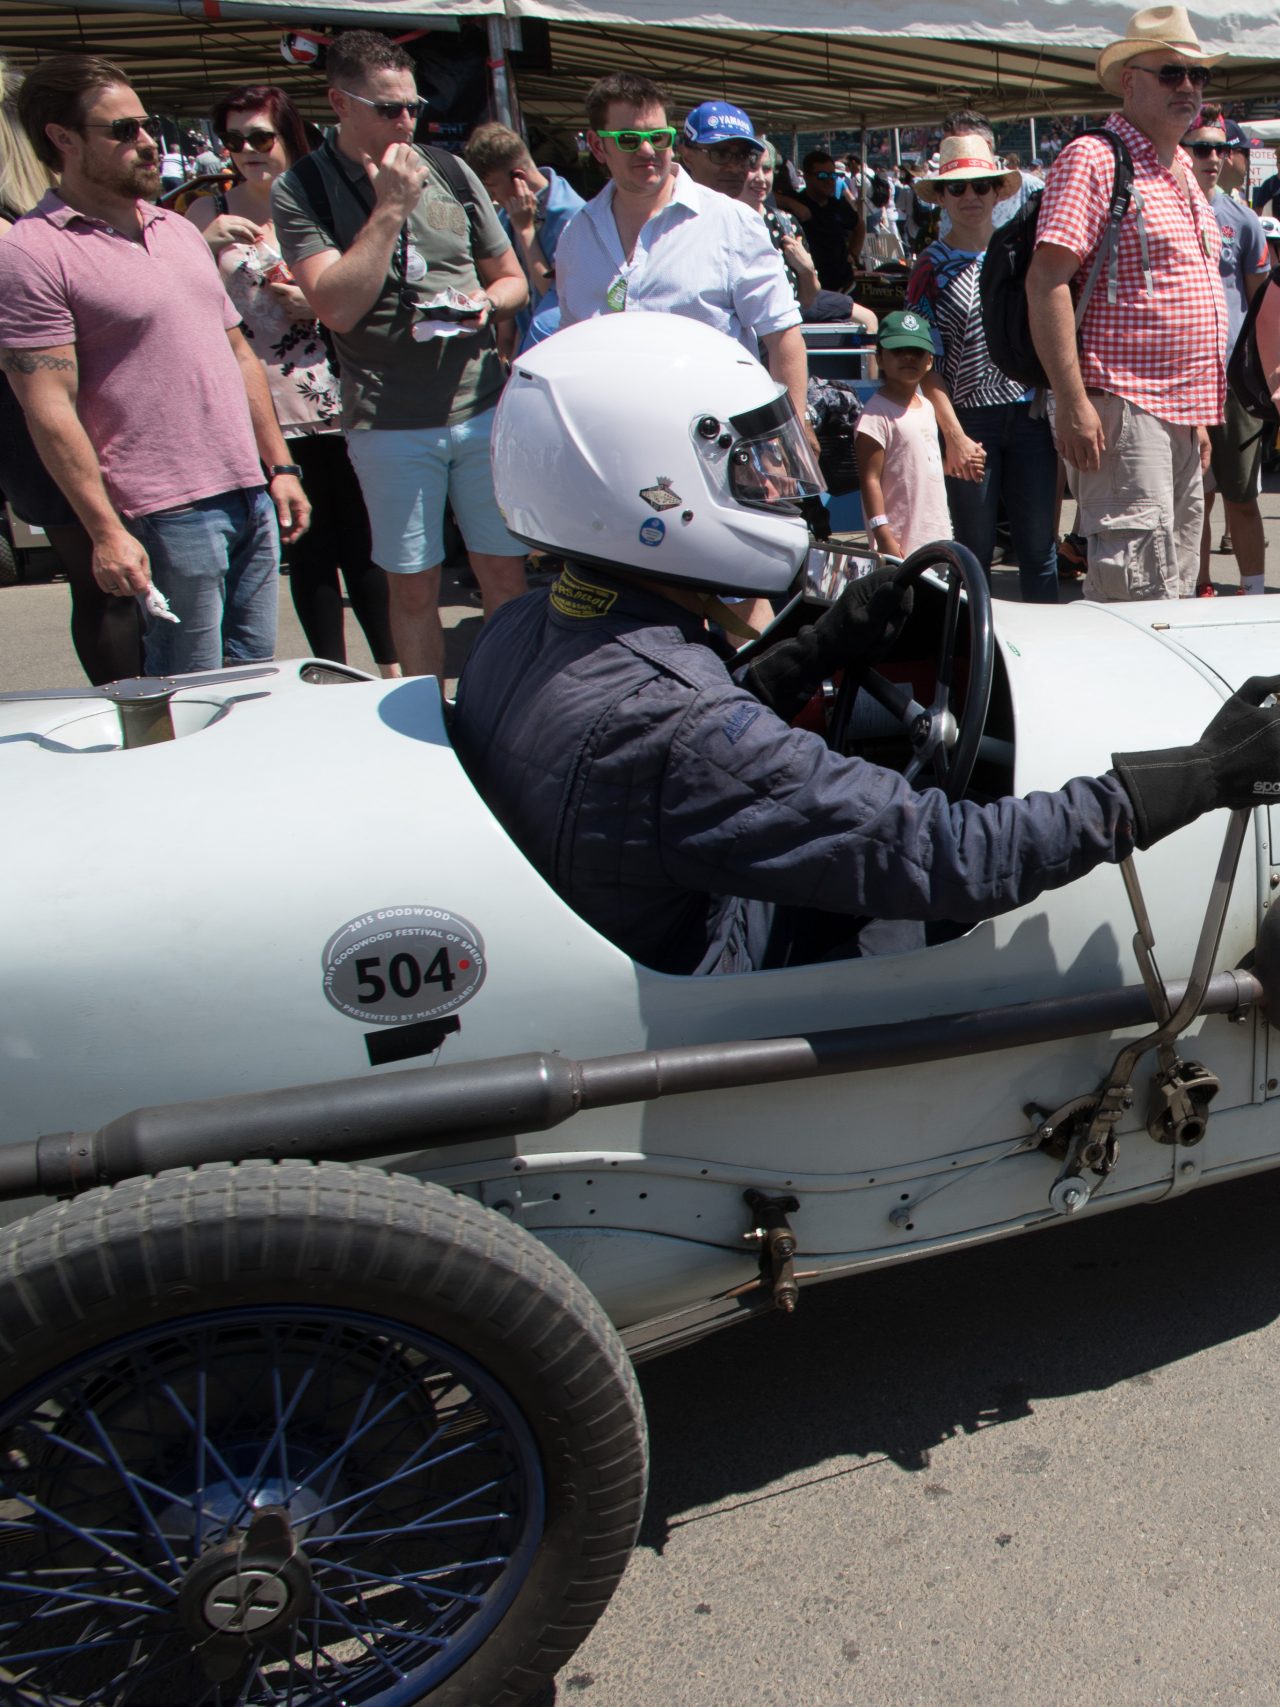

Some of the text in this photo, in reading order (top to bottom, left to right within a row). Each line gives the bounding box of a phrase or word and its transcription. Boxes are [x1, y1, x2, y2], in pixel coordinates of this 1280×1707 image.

[718, 115, 751, 131] YAMAHA
[348, 907, 451, 932] 2015 GOODWOOD
[325, 928, 483, 986] 2019 GOODWOOD FESTIVAL OF SPEED
[355, 946, 456, 1004] 504
[341, 985, 475, 1022] PRESENTED BY MASTERCARD
